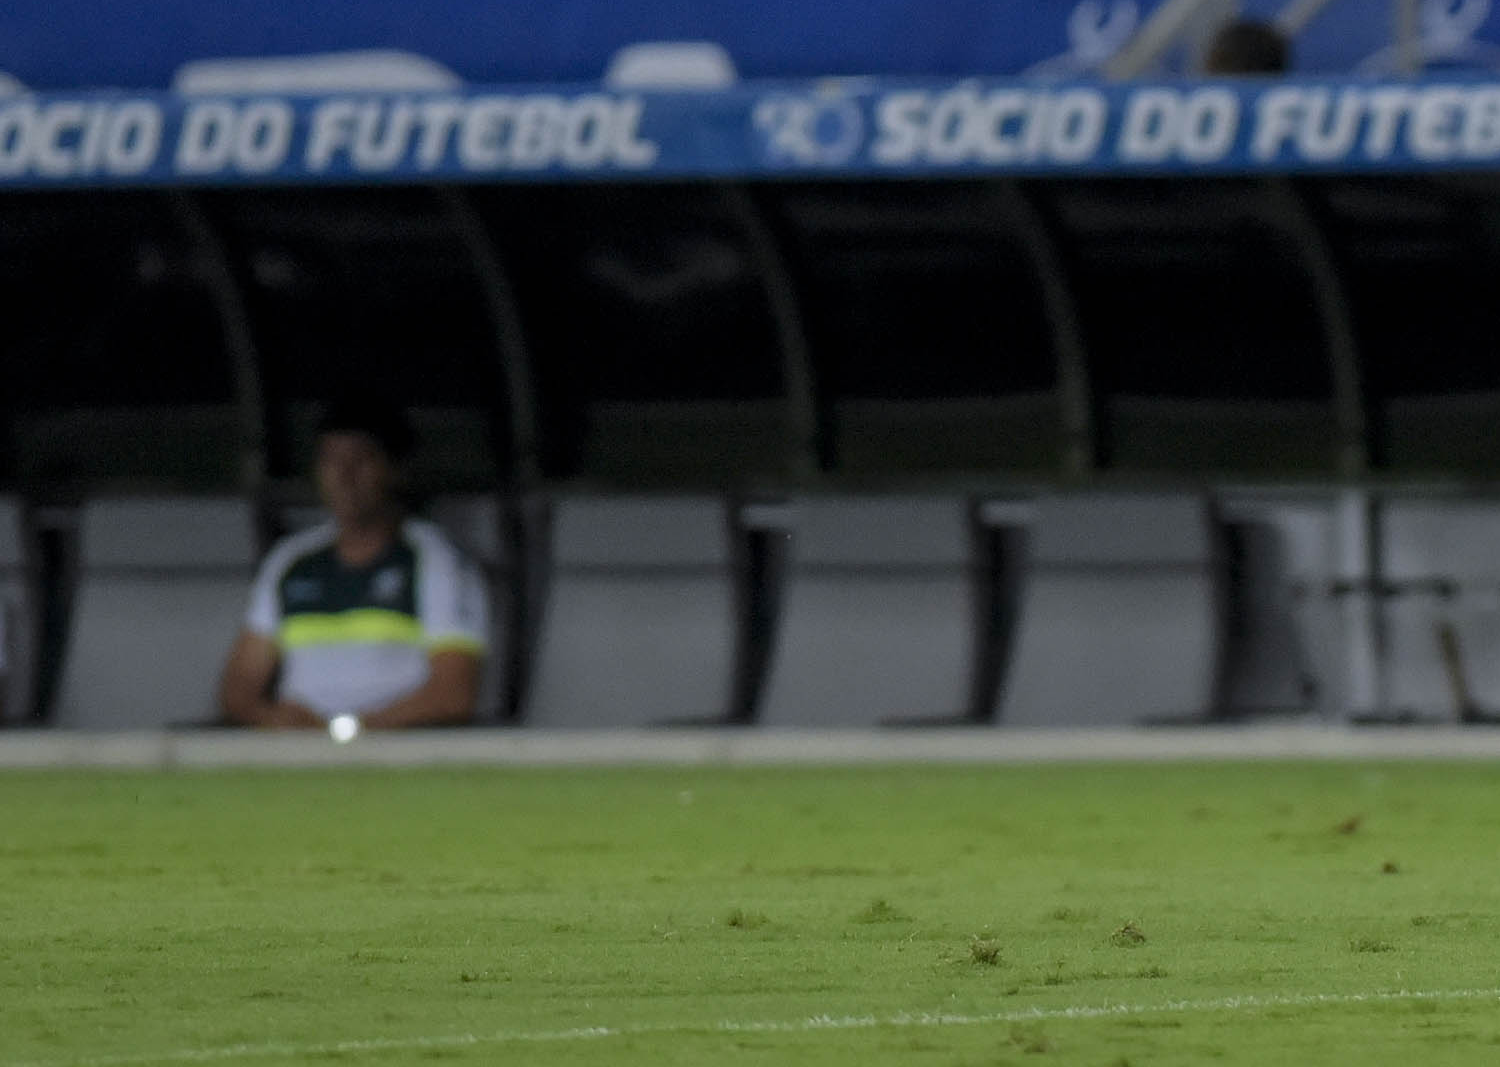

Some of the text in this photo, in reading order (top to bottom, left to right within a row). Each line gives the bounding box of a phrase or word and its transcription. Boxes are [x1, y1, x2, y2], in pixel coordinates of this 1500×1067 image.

[174, 98, 294, 174] DO
[304, 93, 659, 173] FUTEBOL
[872, 80, 1107, 166] SÓCIO
[1117, 86, 1240, 164] DO
